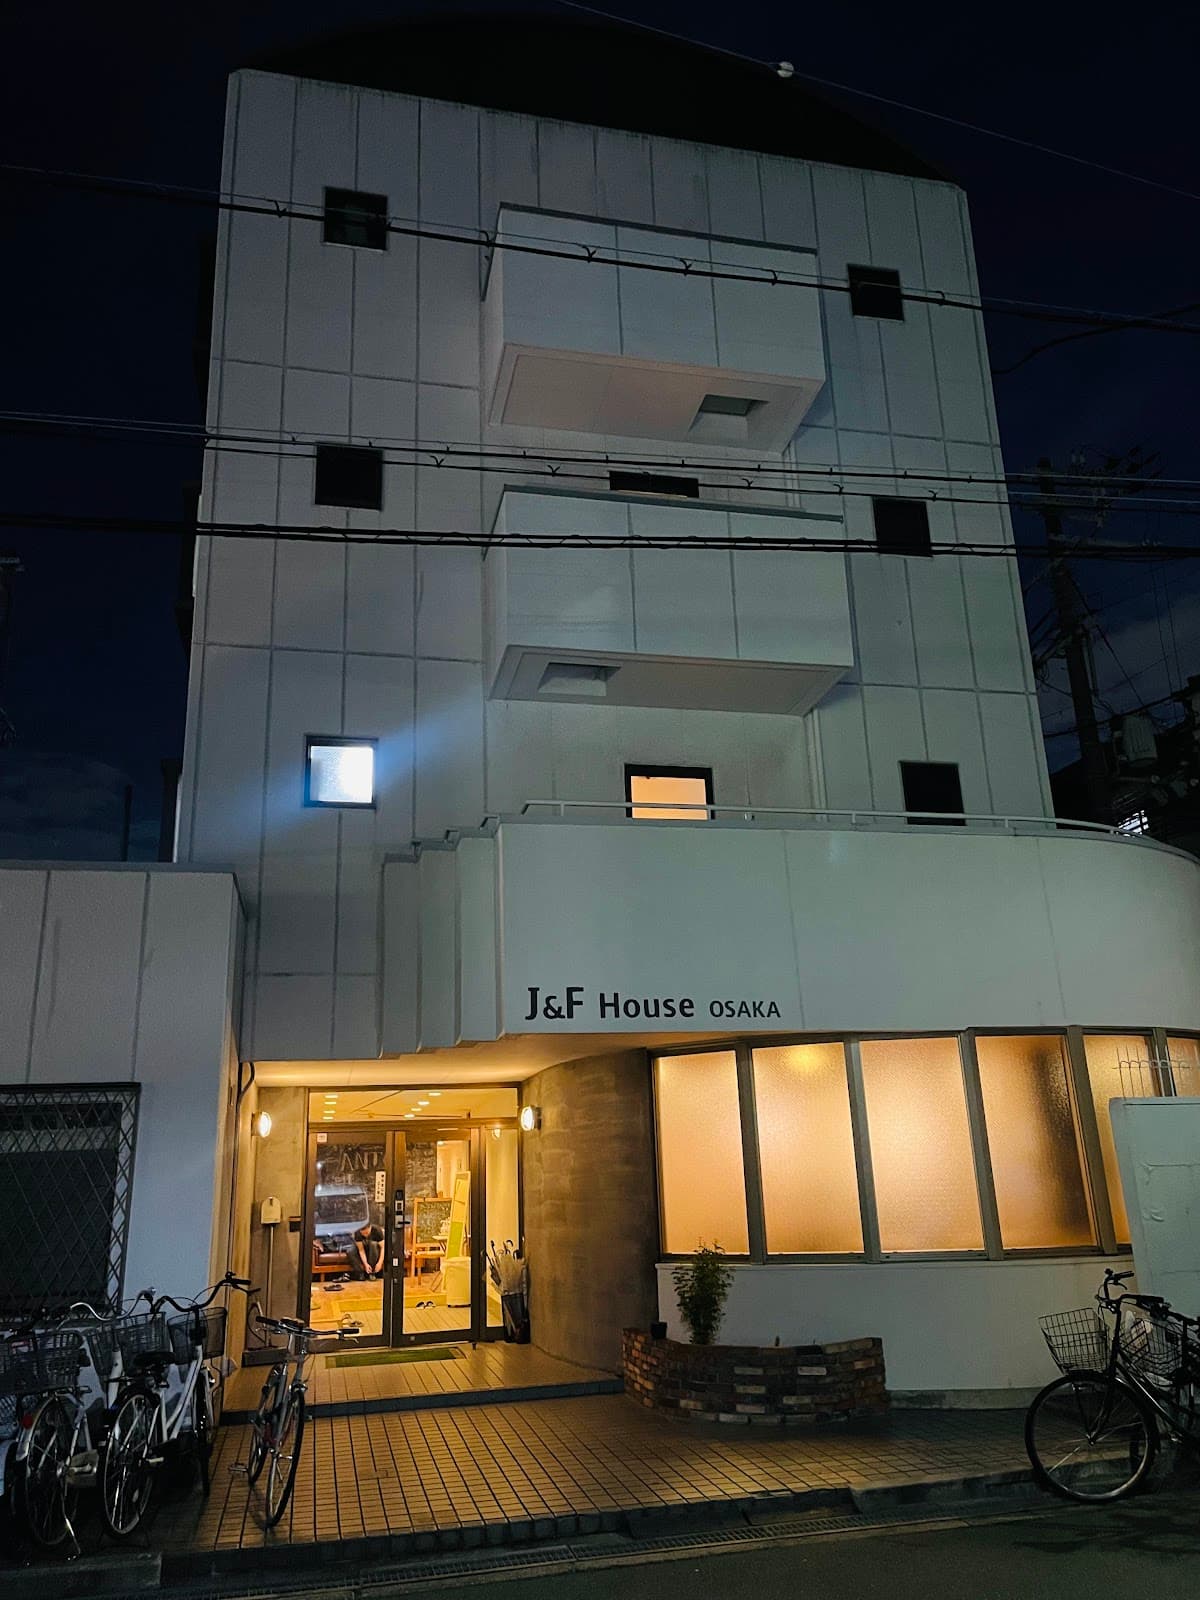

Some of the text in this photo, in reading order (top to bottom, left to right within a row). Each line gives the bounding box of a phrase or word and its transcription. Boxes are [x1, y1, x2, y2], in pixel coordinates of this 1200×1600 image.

[525, 986, 781, 1020] J&F House OSAKA
